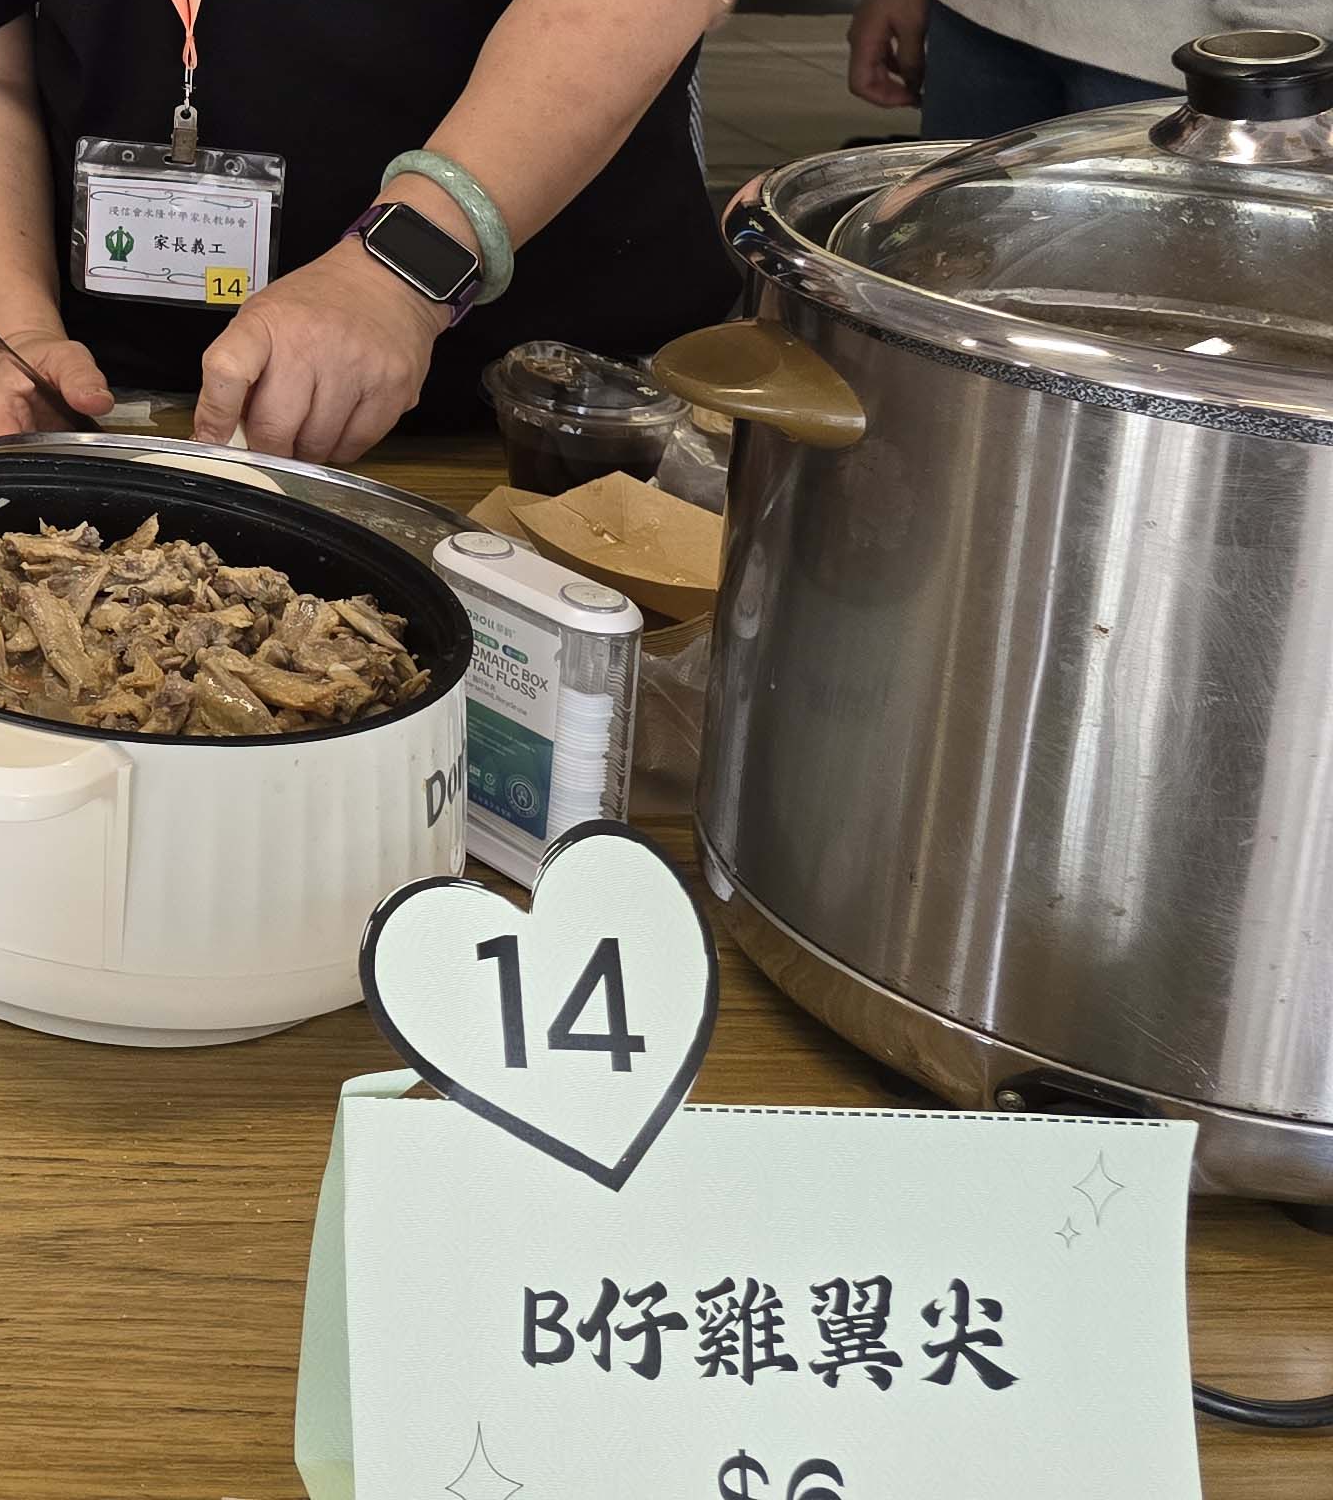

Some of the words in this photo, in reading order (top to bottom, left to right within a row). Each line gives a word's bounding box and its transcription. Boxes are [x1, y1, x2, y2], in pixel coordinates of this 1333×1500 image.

[153, 233, 227, 256] 家長義工
[212, 276, 244, 298] 14
[496, 669, 537, 700] FLOSS
[521, 667, 549, 693] BOX
[476, 934, 646, 1073] 14
[522, 1274, 1020, 1392] B仔雞翼尖
